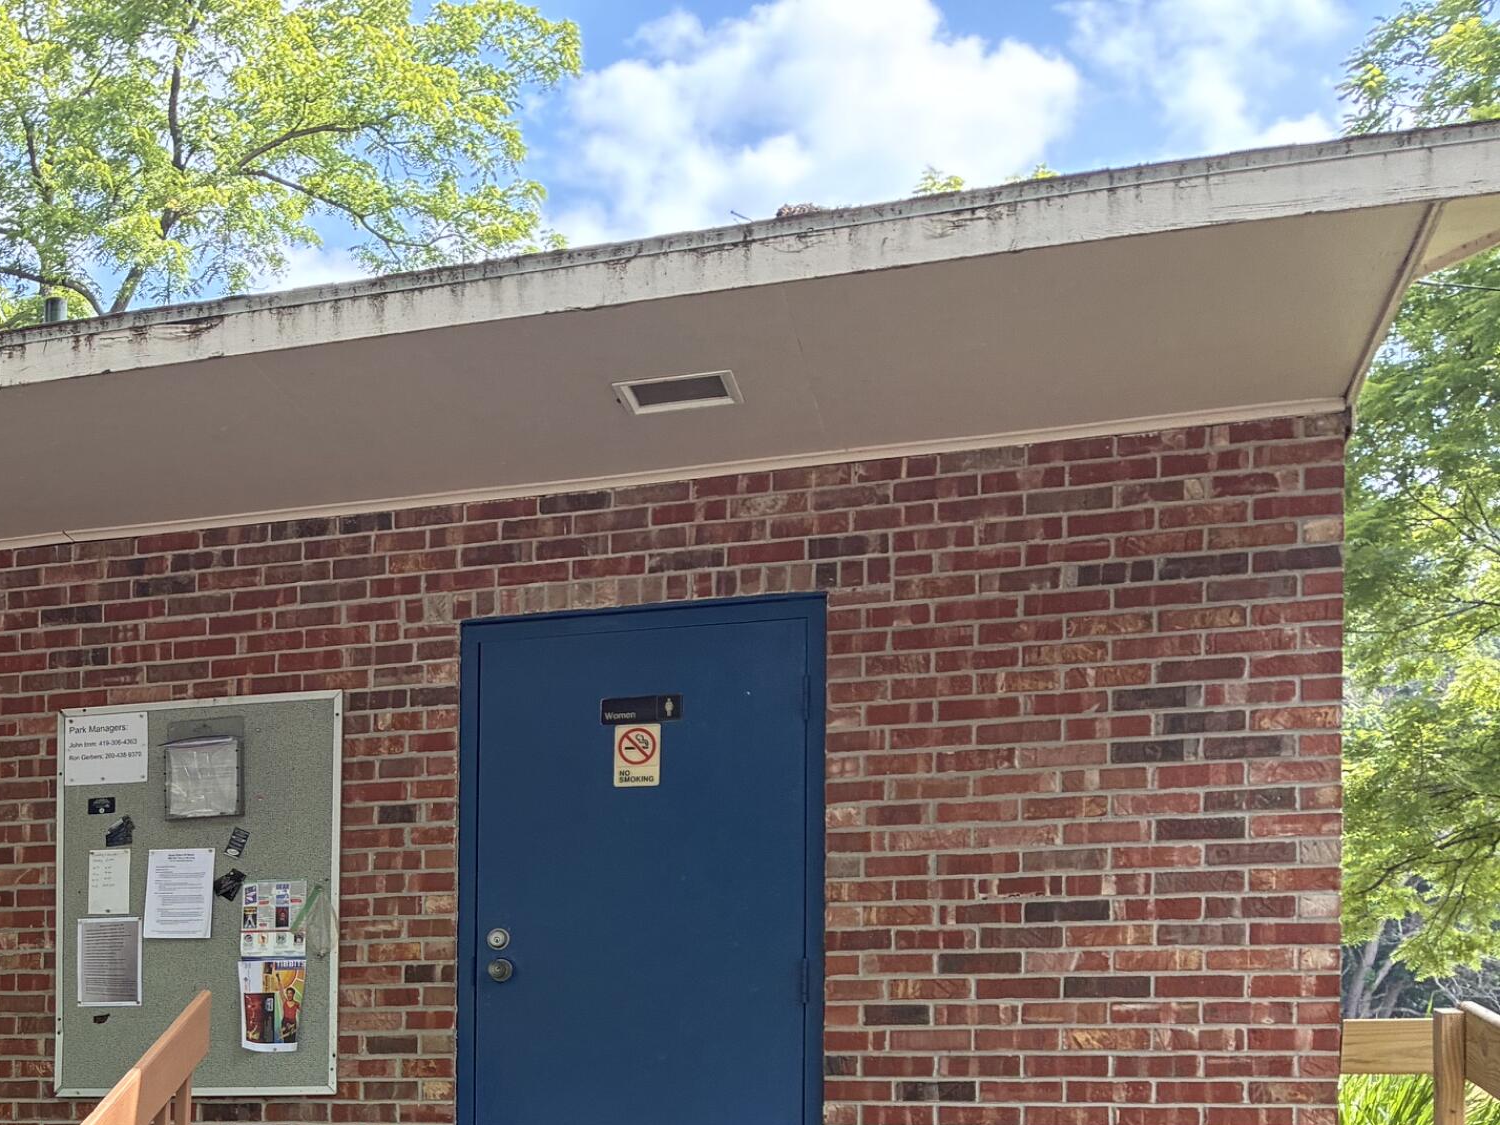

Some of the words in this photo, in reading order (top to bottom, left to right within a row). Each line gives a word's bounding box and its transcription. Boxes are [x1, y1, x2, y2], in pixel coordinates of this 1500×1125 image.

[604, 711, 637, 720] Women
[69, 726, 87, 734] Park
[88, 724, 128, 734] Managers:
[619, 775, 654, 783] SMOKING
